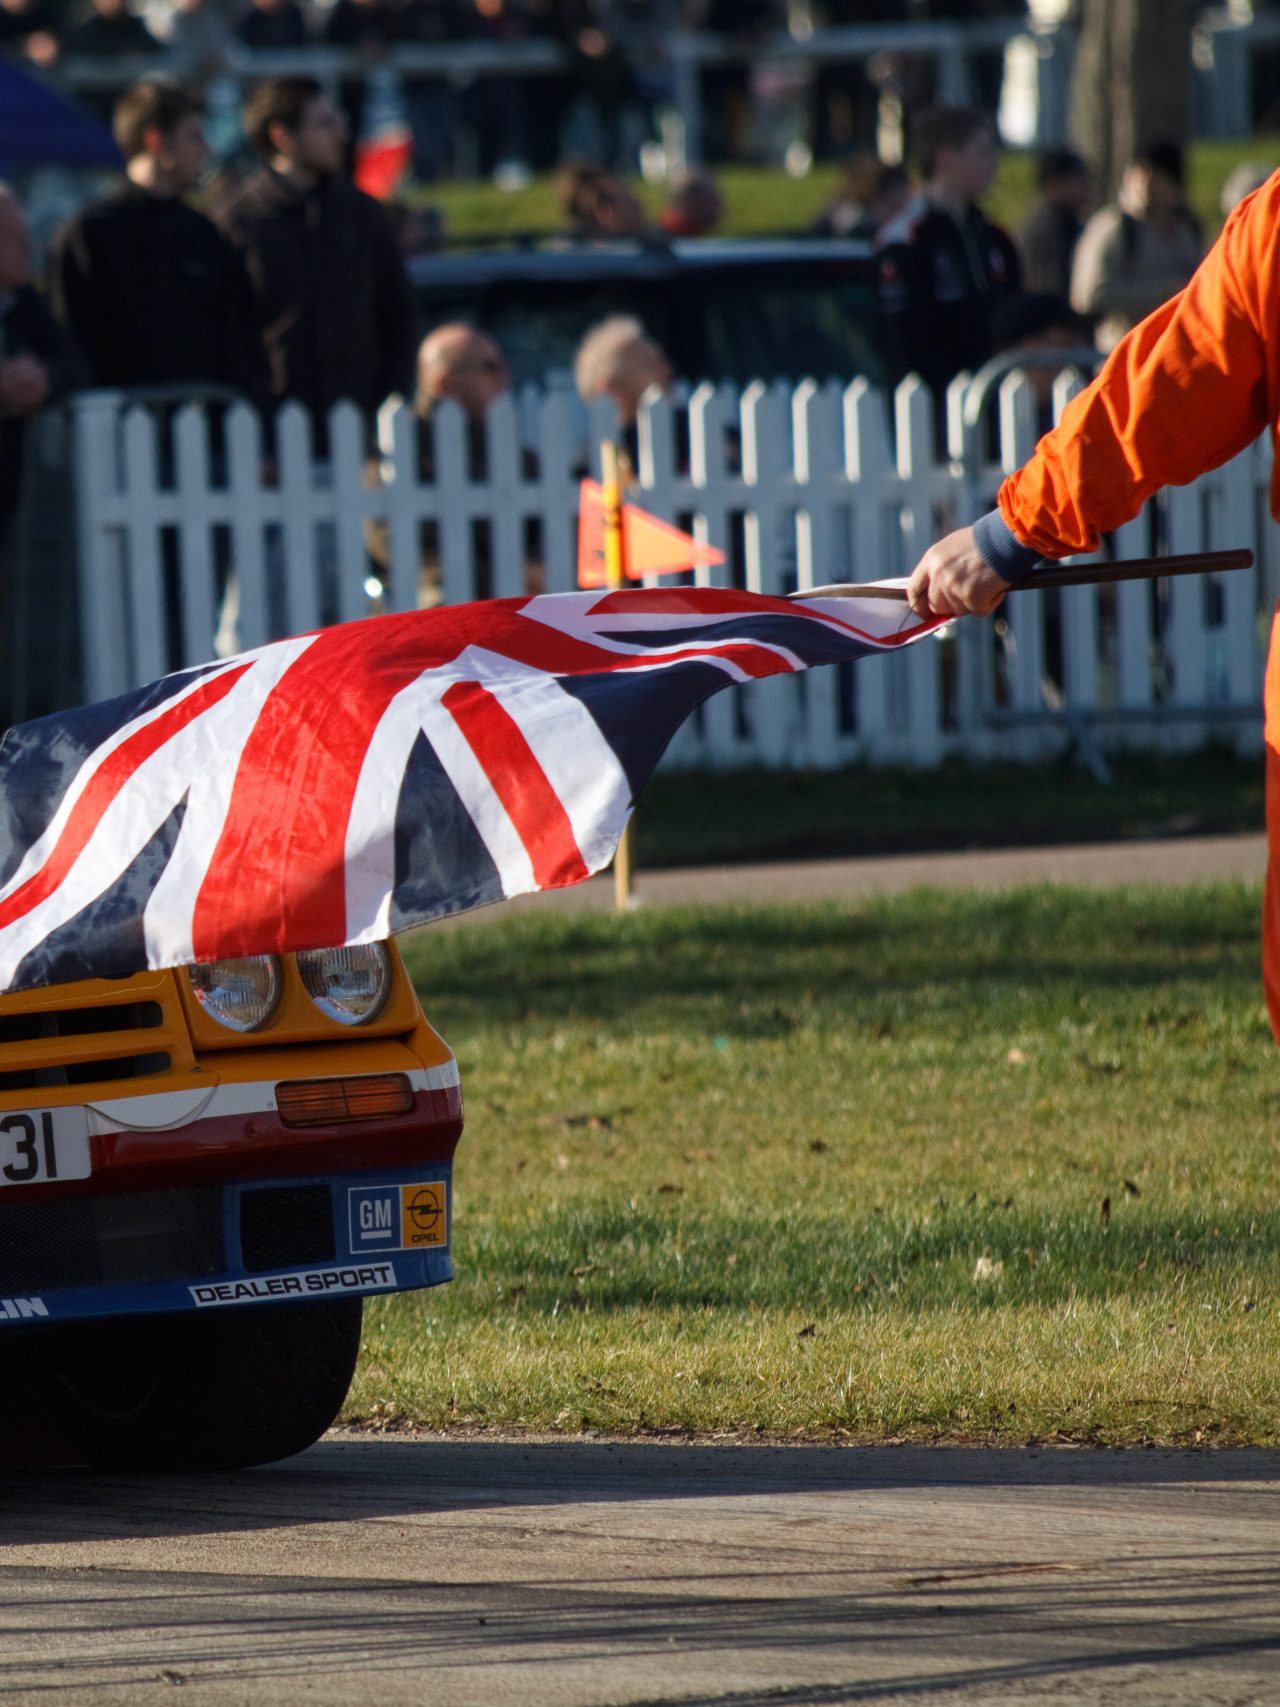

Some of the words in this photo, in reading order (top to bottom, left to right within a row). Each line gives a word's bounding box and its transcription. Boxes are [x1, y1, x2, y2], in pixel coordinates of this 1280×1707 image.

[0, 1112, 58, 1182] 31
[359, 1199, 392, 1230] GM
[411, 1233, 439, 1244] OPEL
[194, 1278, 307, 1303] DEALER
[308, 1265, 391, 1291] SPORT
